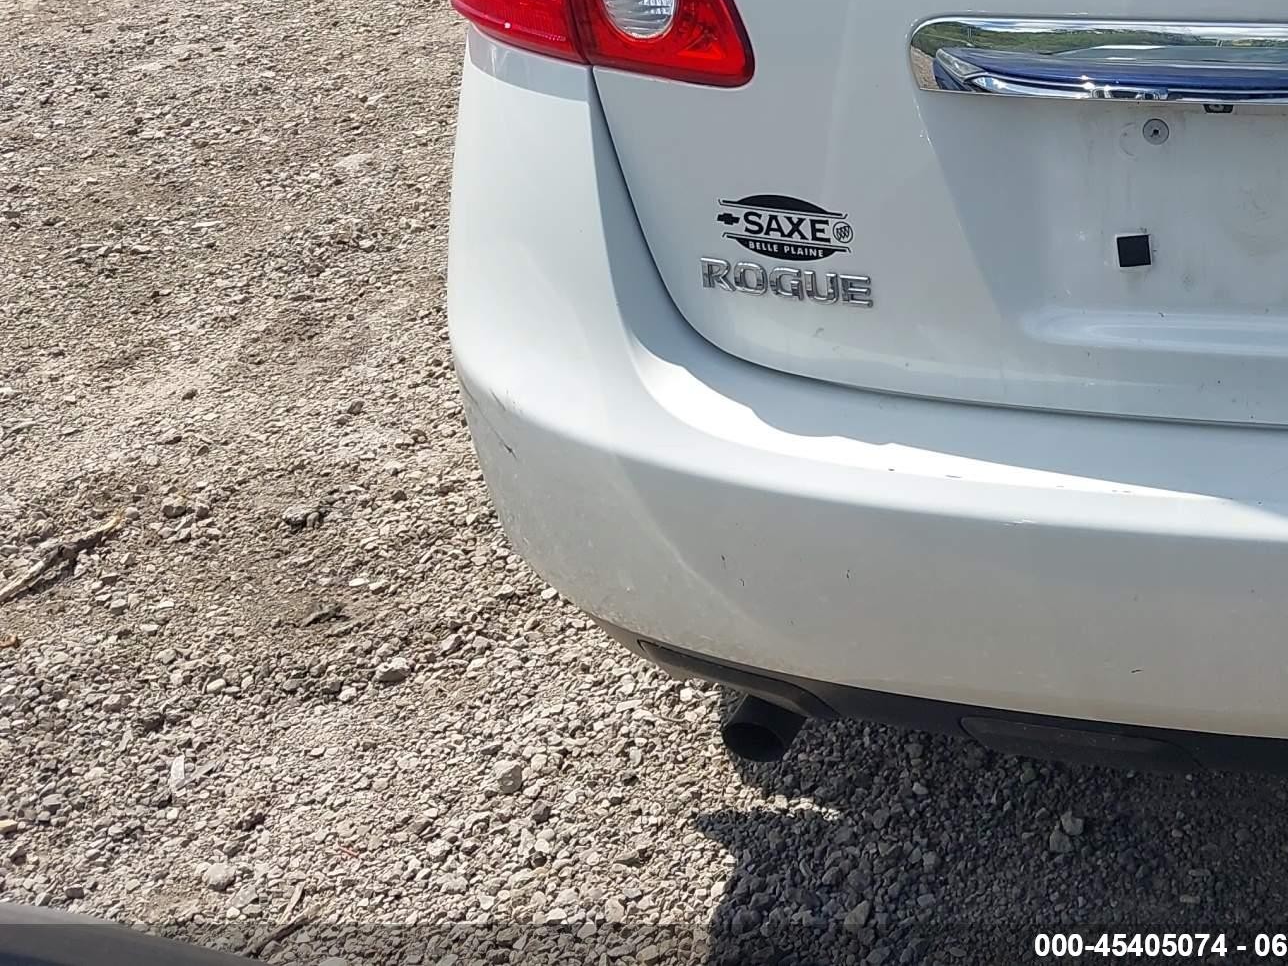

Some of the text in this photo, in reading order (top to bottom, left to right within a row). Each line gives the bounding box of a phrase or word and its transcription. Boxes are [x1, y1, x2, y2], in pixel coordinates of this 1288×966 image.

[743, 211, 832, 243] SAXE
[748, 241, 824, 258] BELLE PLAINE
[700, 257, 873, 308] ROGUE
